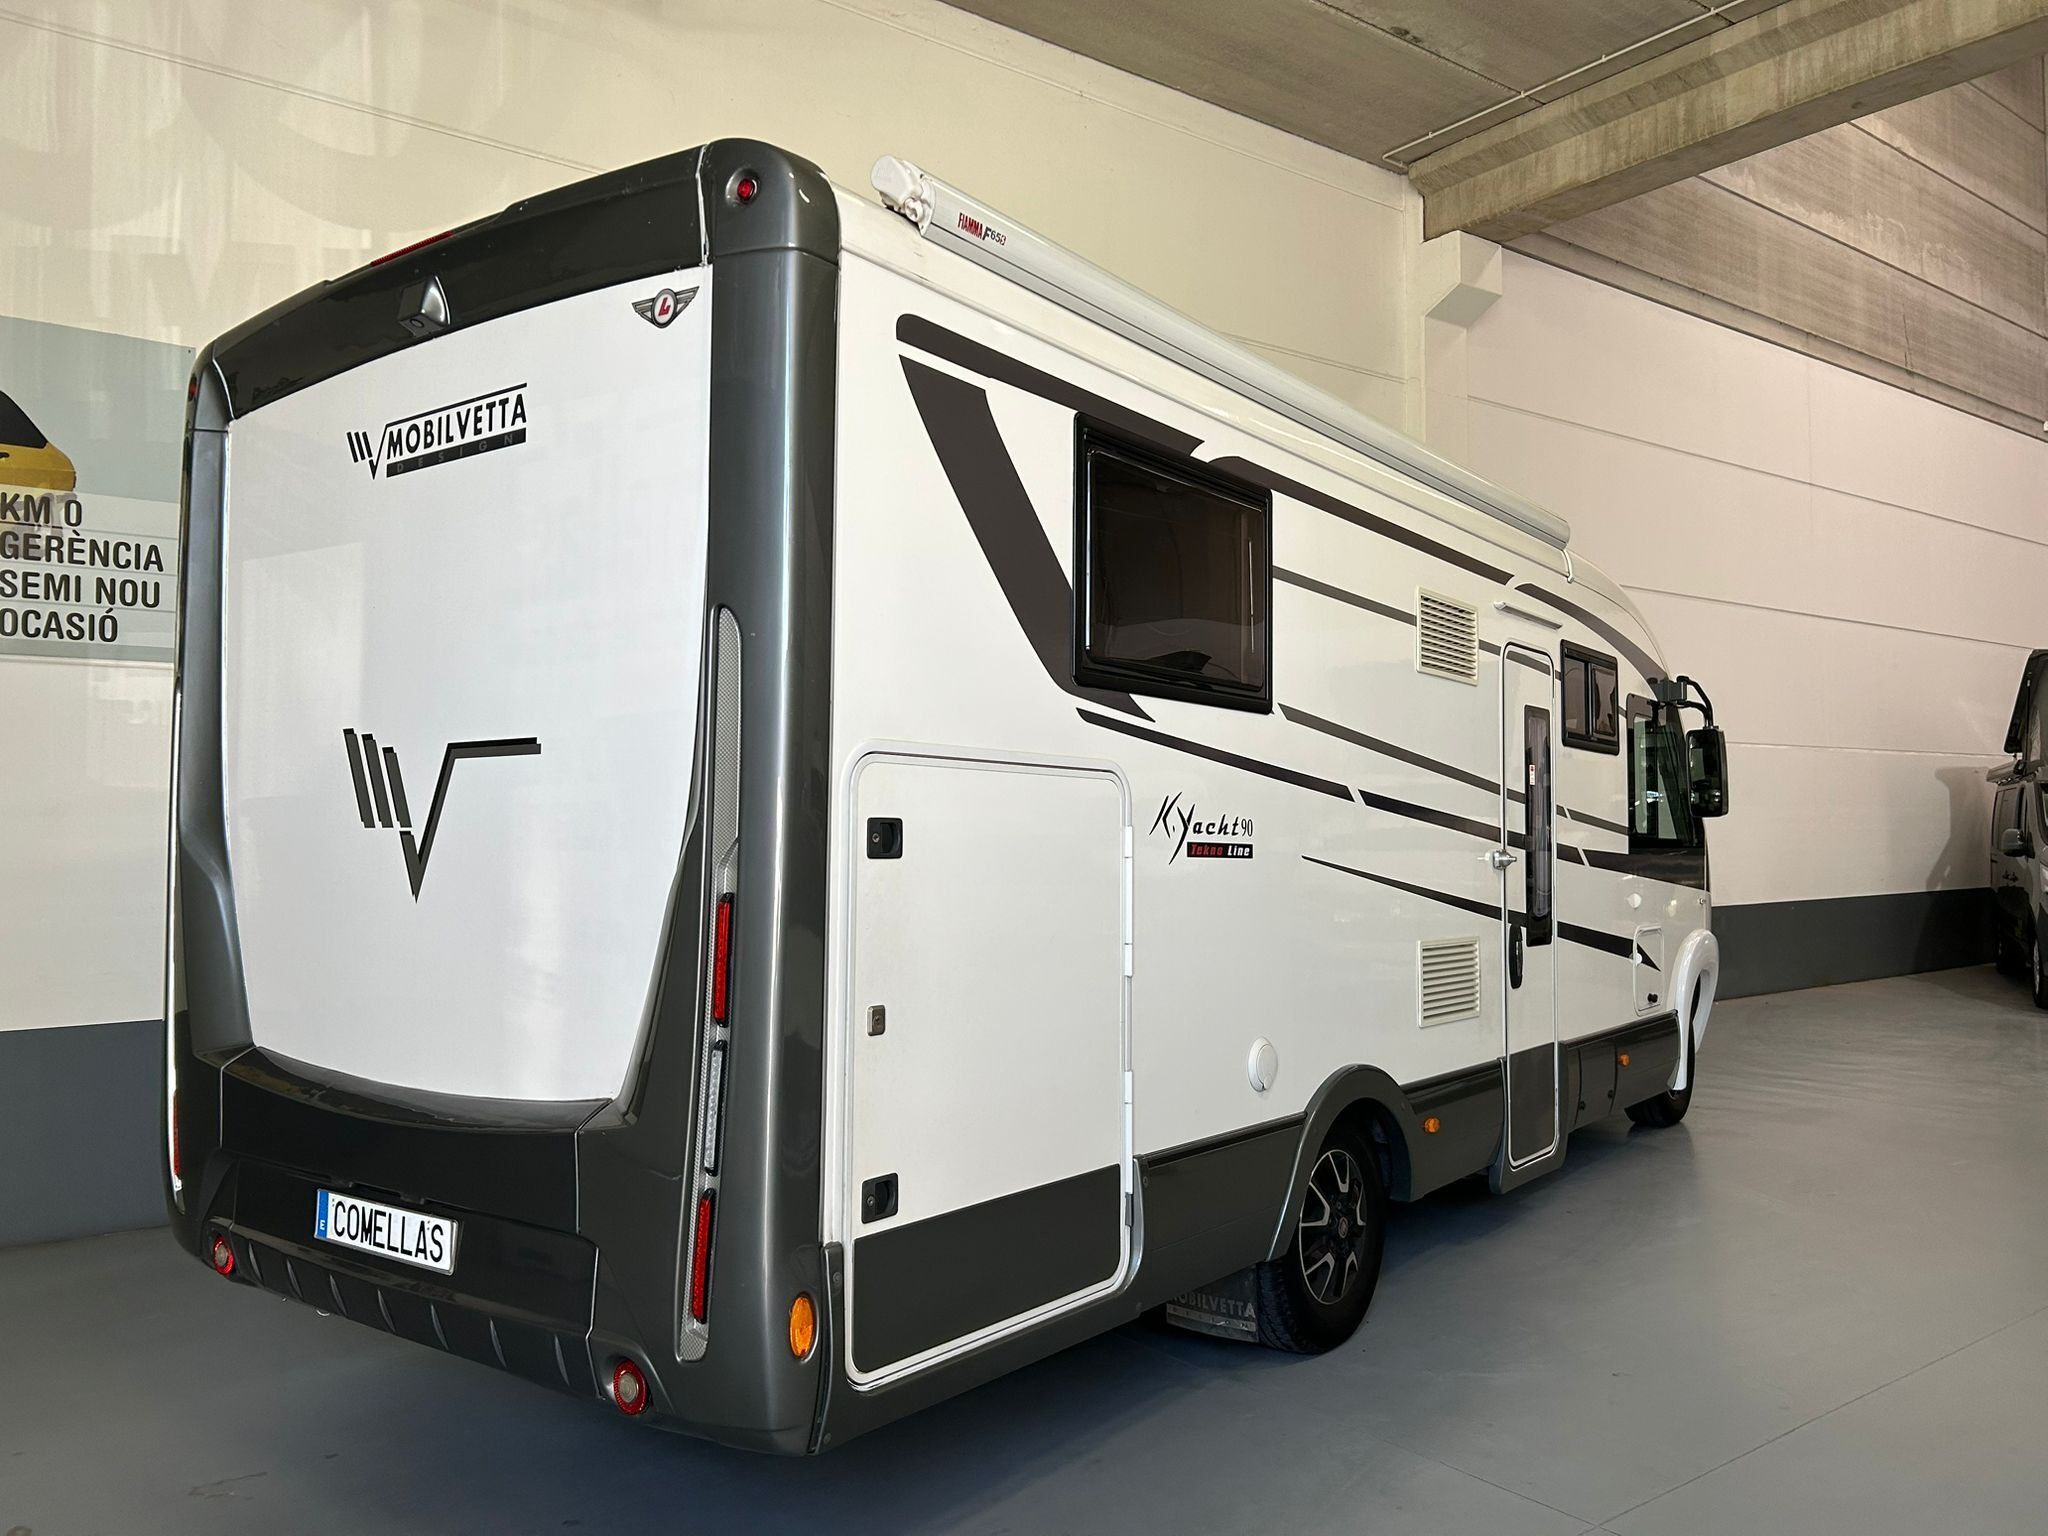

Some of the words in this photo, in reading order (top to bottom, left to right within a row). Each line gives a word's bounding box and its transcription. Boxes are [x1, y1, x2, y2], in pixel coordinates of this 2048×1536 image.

[958, 212, 983, 239] FIAMMA
[387, 393, 527, 460] MOBILVETTA
[396, 435, 514, 473] DESIGN
[0, 492, 51, 524] KM
[0, 529, 164, 572] GERÈNCIA
[0, 569, 81, 603] SEMI
[95, 577, 160, 608] NOU
[0, 607, 118, 643] OCASIÓ
[1227, 845, 1250, 856] Line
[334, 1201, 444, 1263] COMELLAS
